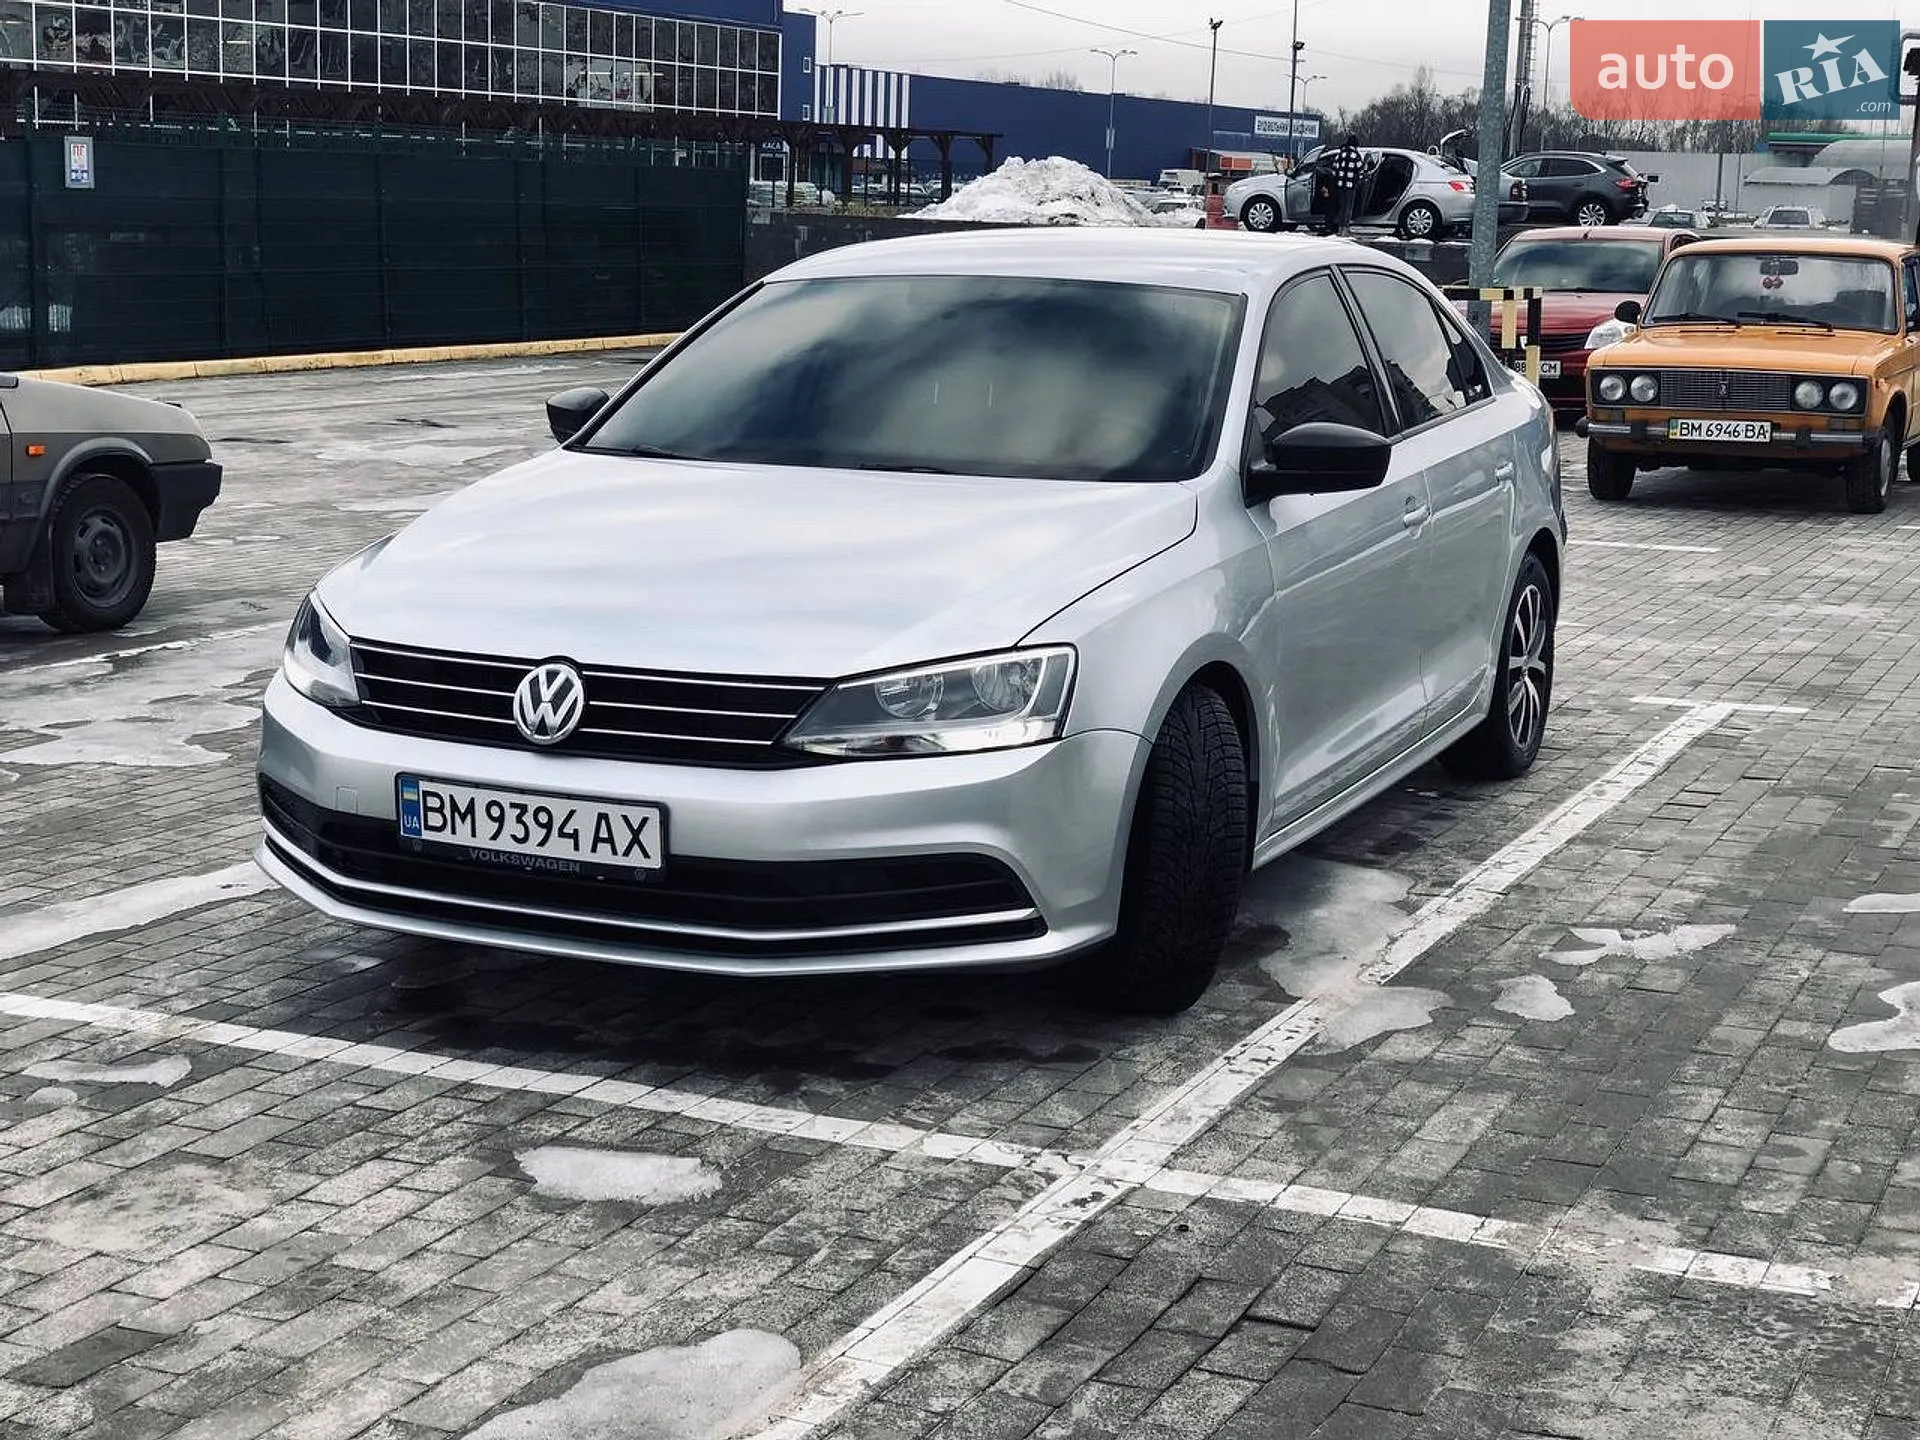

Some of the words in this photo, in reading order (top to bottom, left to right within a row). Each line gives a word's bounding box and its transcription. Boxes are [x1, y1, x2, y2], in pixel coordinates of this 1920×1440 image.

[1515, 361, 1527, 373] 88
[1541, 363, 1557, 373] CM
[1680, 422, 1702, 437] BM
[1705, 423, 1741, 438] 6946
[1745, 424, 1767, 439] BA
[404, 815, 420, 829] UA
[421, 790, 477, 838] BM
[485, 799, 580, 851] 9394
[590, 812, 651, 859] AX
[469, 847, 581, 873] VOLKSWAGEN
